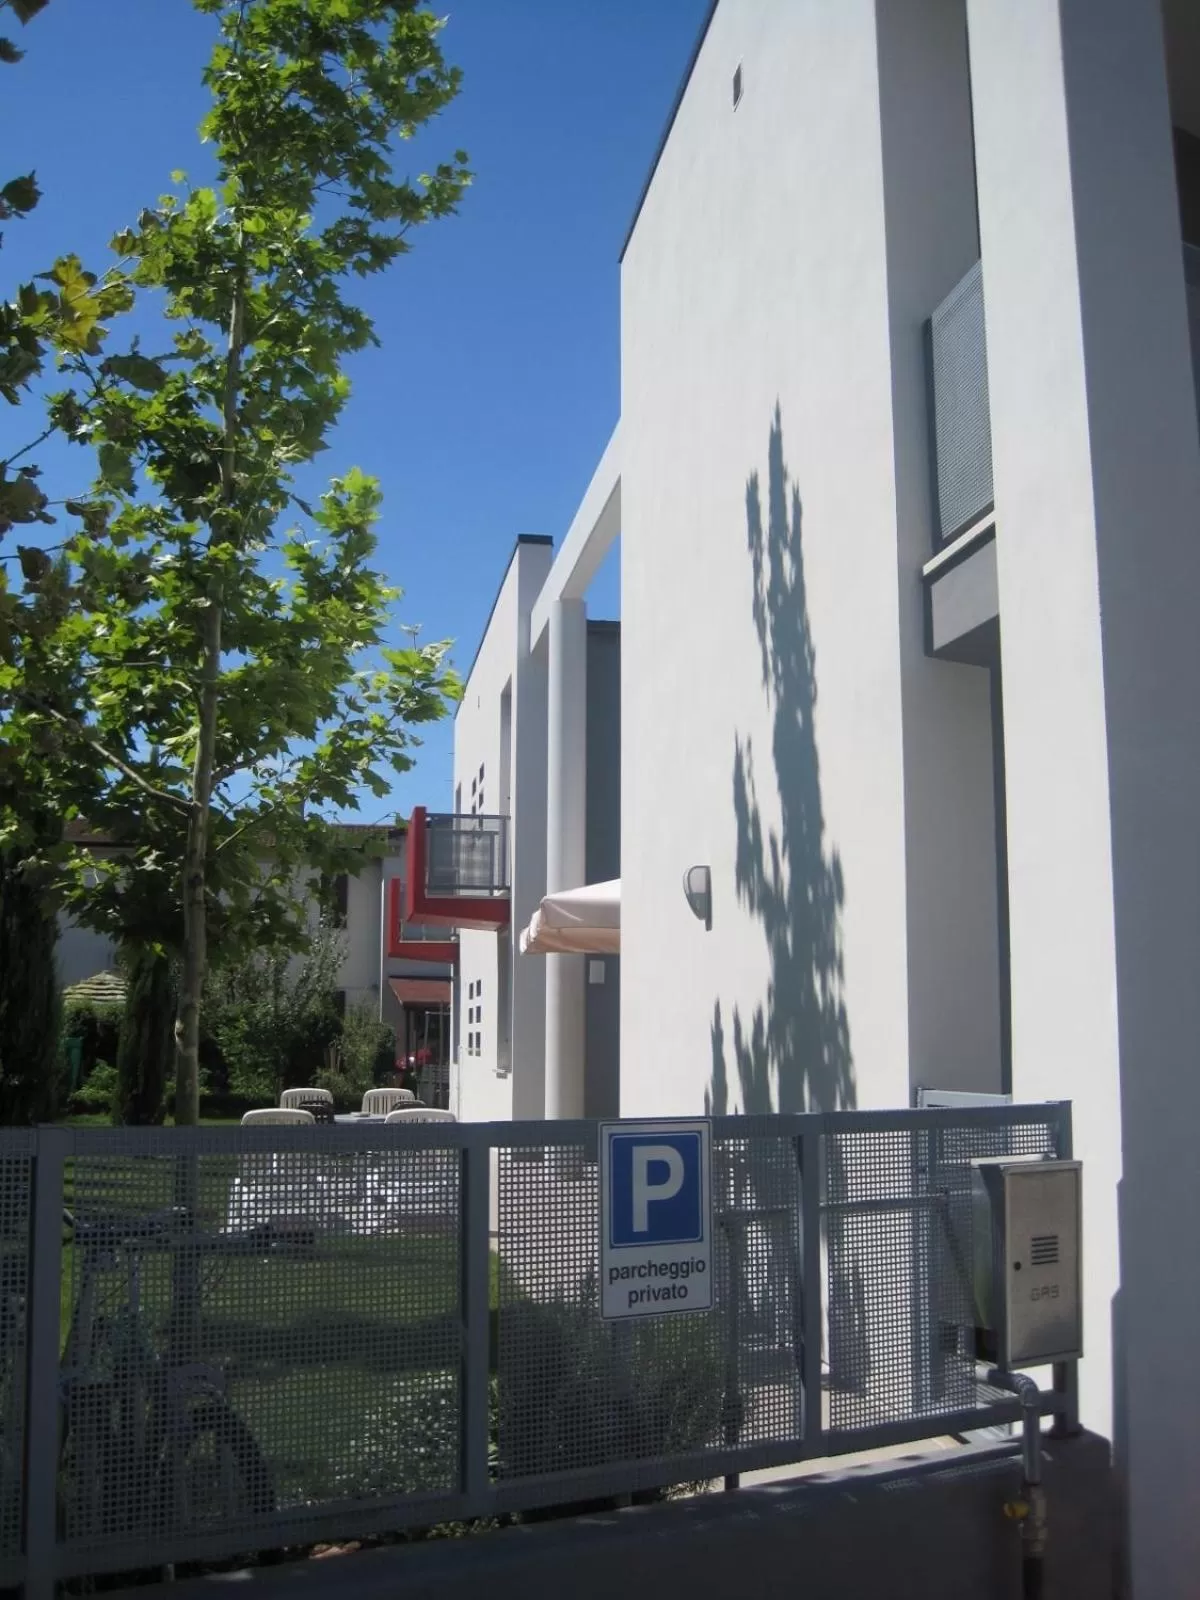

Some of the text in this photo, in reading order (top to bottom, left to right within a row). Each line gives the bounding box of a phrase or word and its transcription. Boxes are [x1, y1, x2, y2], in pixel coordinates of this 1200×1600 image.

[632, 1144, 685, 1232] P
[608, 1256, 706, 1285] parcheggio
[628, 1283, 688, 1308] privato
[1030, 1284, 1060, 1301] GAS
